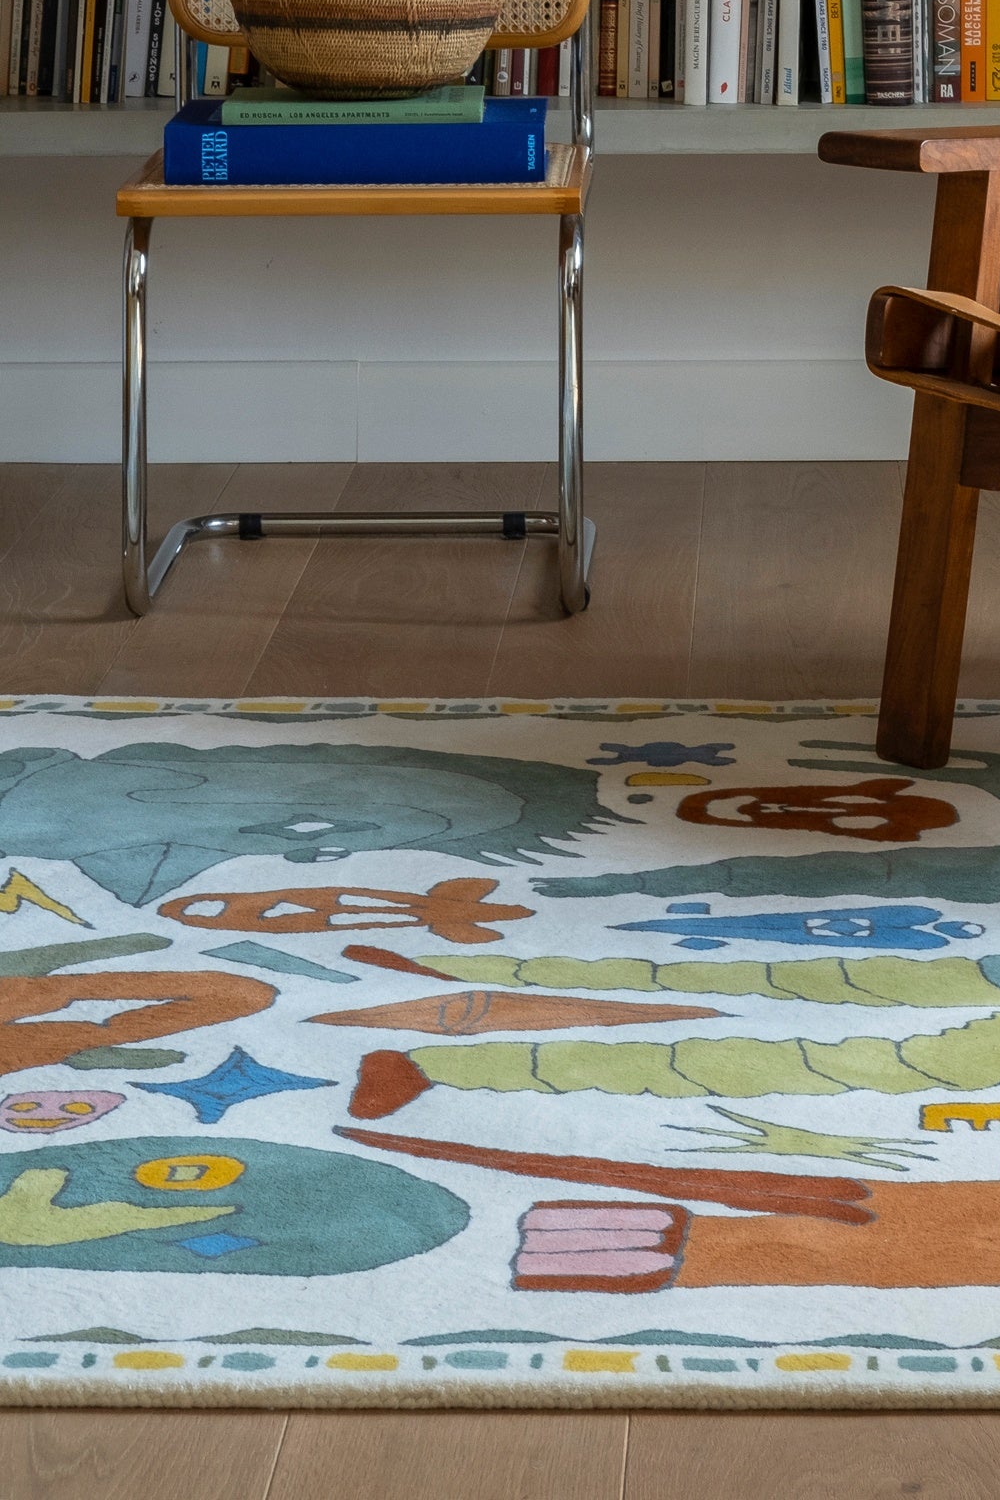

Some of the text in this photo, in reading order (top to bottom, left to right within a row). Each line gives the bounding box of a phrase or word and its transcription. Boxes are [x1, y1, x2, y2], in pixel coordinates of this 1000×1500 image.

[965, 0, 974, 46] MARCEL
[240, 111, 390, 119] ED RUSCHA LOS ANGELES APARTMENTS
[201, 132, 215, 181] PETER
[215, 130, 228, 181] BEARD
[527, 134, 536, 171] TASCHEN
